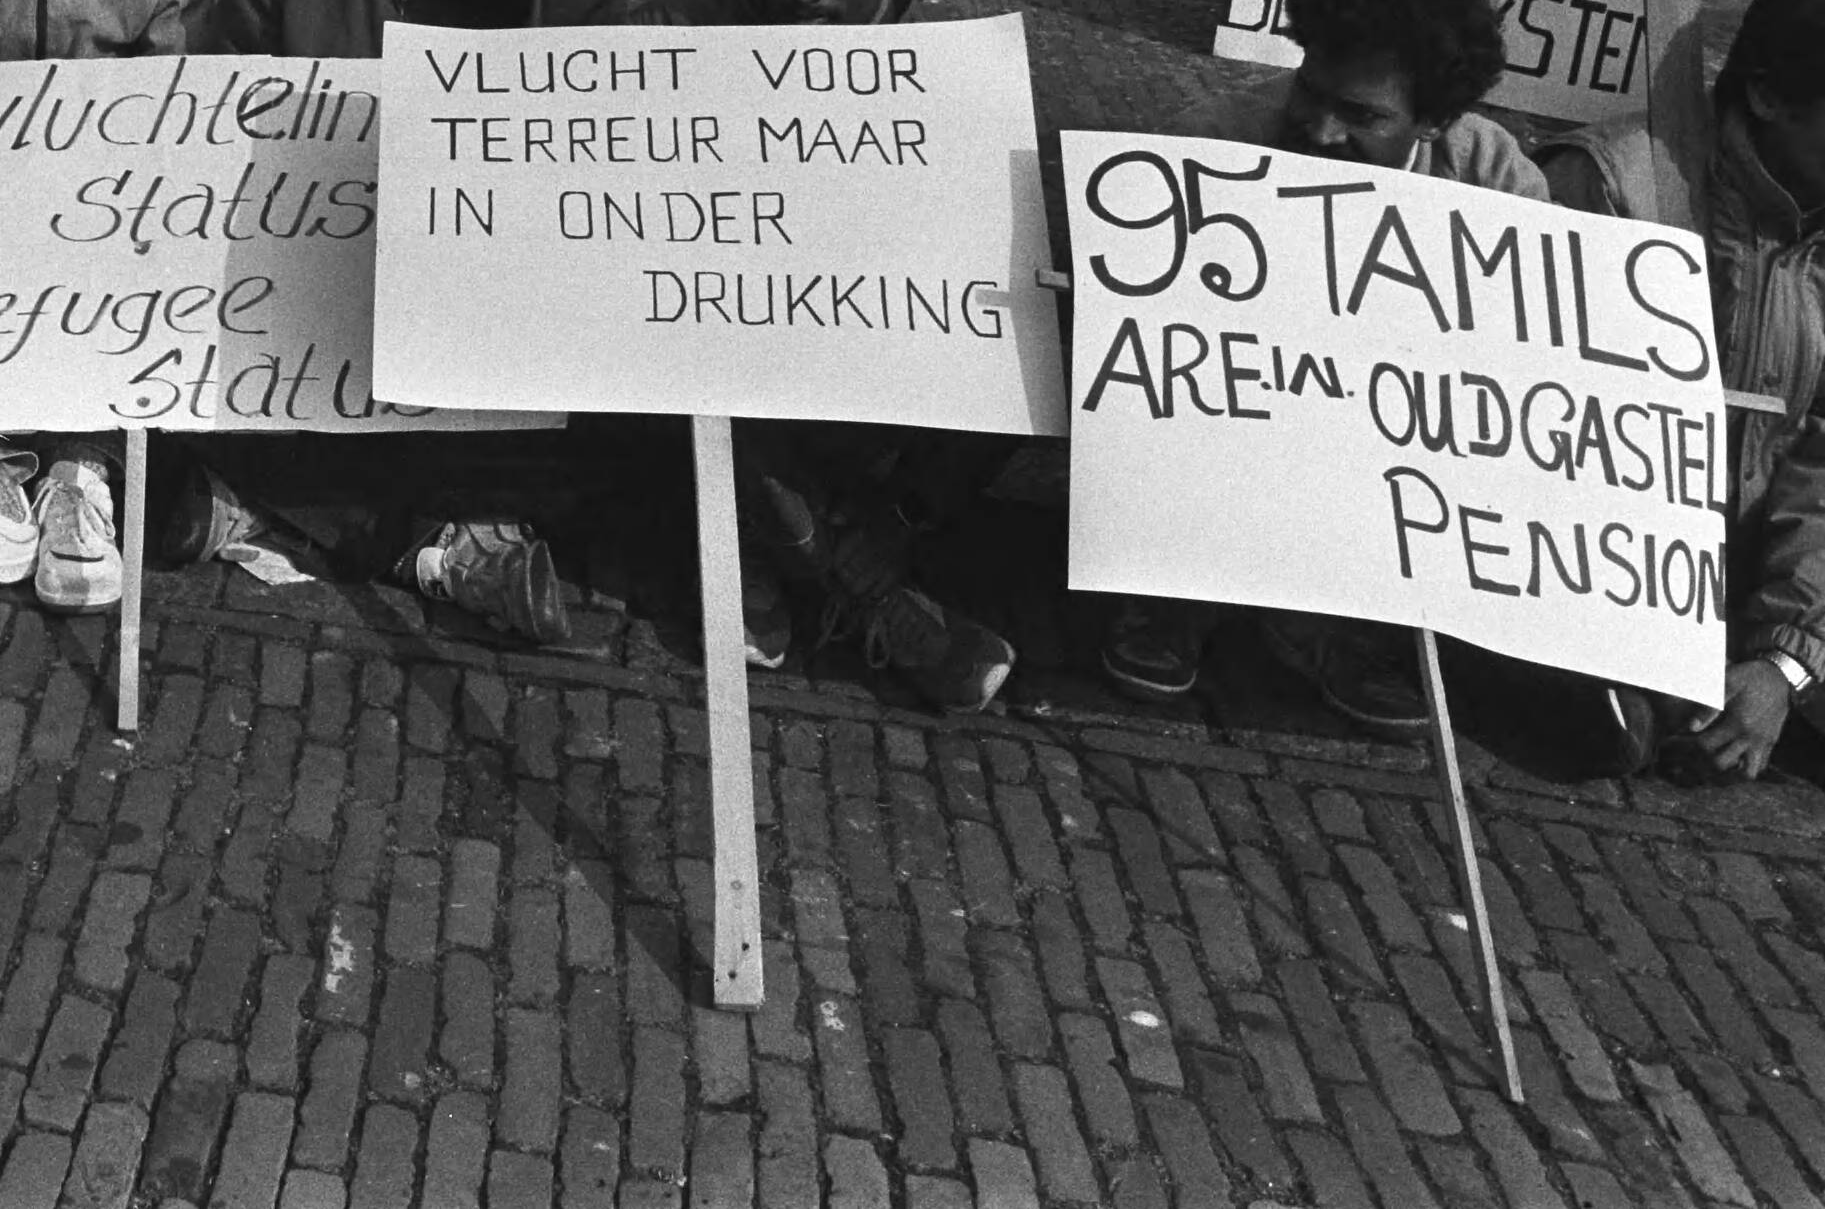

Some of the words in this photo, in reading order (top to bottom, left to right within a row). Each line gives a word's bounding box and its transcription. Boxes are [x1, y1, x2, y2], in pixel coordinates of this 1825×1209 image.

[424, 47, 698, 96] VLUCHT
[752, 47, 927, 96] VOOR
[430, 116, 725, 165] TERREUR
[757, 116, 929, 167] MAAR
[429, 186, 495, 237] IN
[558, 189, 793, 246] ONDER
[1084, 150, 1273, 301] 95
[1277, 180, 1711, 383] TAMILS
[642, 269, 1003, 339] DRUKKING
[1381, 465, 1726, 626] PENSION
